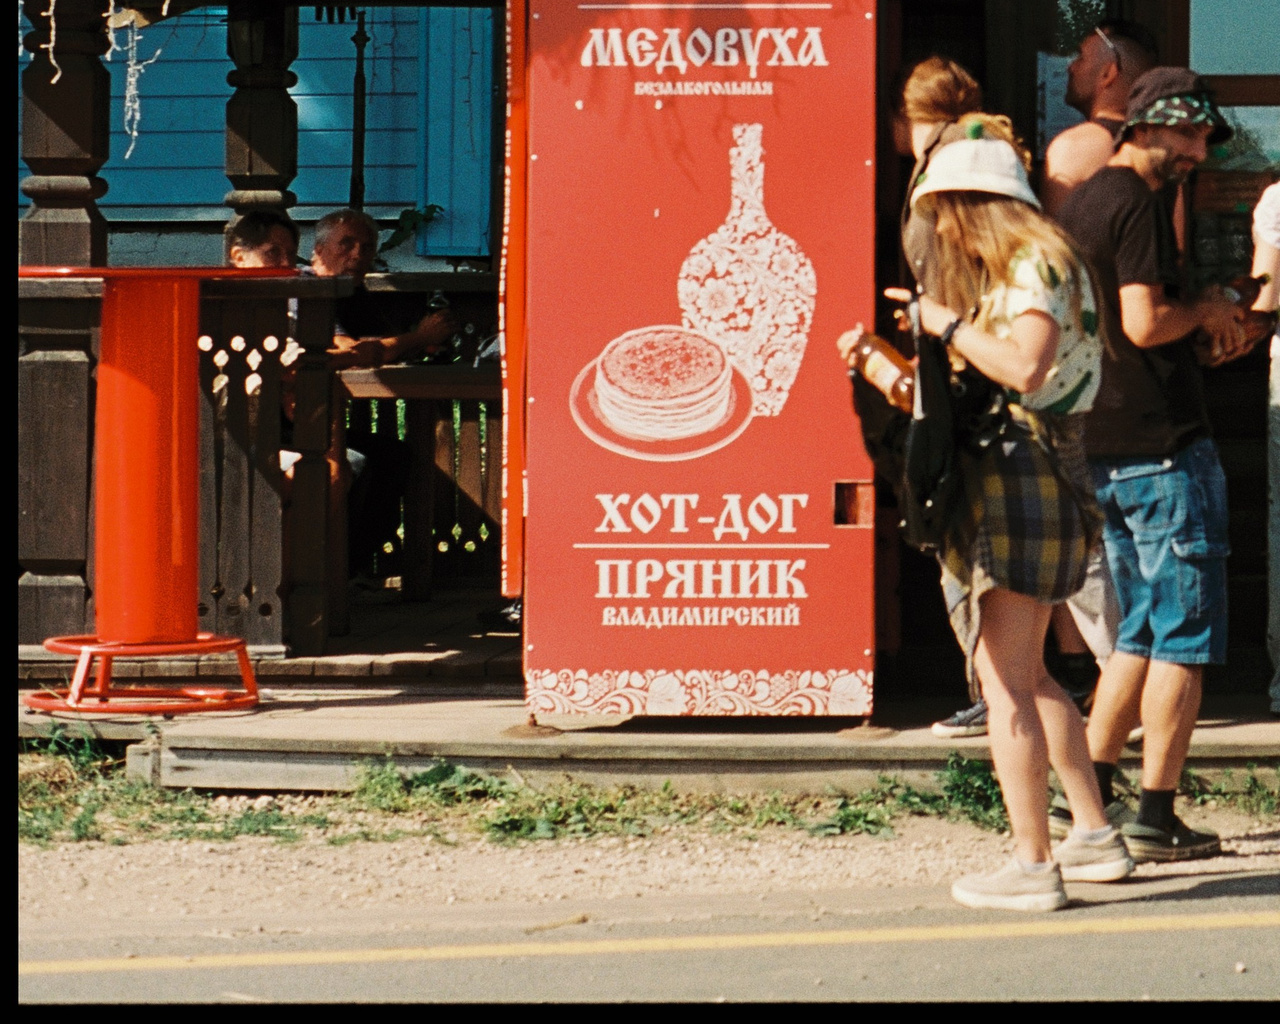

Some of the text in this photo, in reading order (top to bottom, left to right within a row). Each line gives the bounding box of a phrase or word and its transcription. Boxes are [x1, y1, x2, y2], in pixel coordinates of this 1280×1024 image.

[580, 26, 830, 79] МЕДОВУХА
[634, 81, 773, 96] БЕЗАЛКОГОЛЬНАЯ
[594, 492, 809, 542] ХОТ-ДОГ
[594, 558, 809, 599] ПРЯНИК
[601, 603, 801, 629] ВЛАДИМИРСКИЙ
